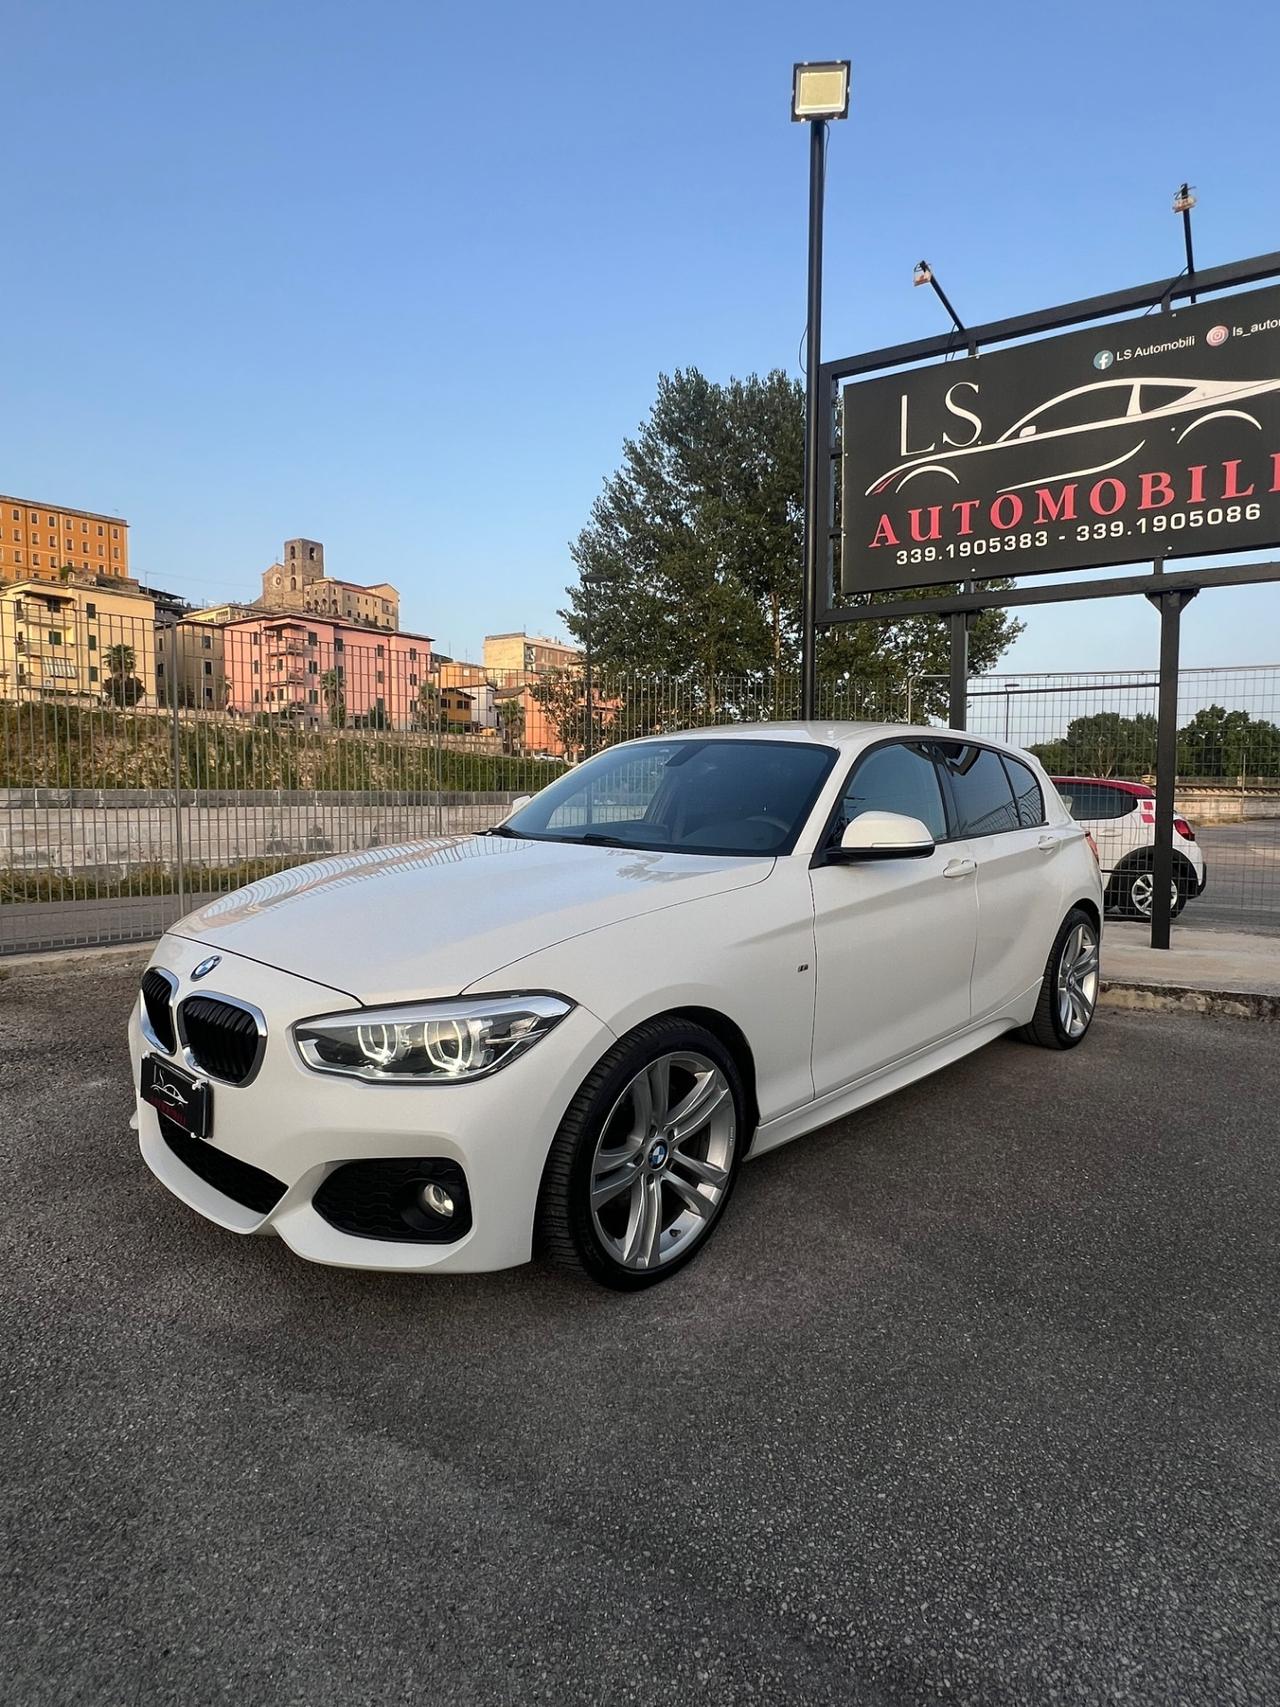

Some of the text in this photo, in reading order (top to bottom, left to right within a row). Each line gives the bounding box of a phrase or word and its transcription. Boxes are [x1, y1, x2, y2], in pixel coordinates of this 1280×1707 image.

[1116, 336, 1195, 361] LS Automobili
[1232, 319, 1280, 337] ls_auto
[901, 382, 982, 456] LS
[896, 530, 1048, 565] 339.1905383
[1076, 503, 1261, 542] 339.1905086
